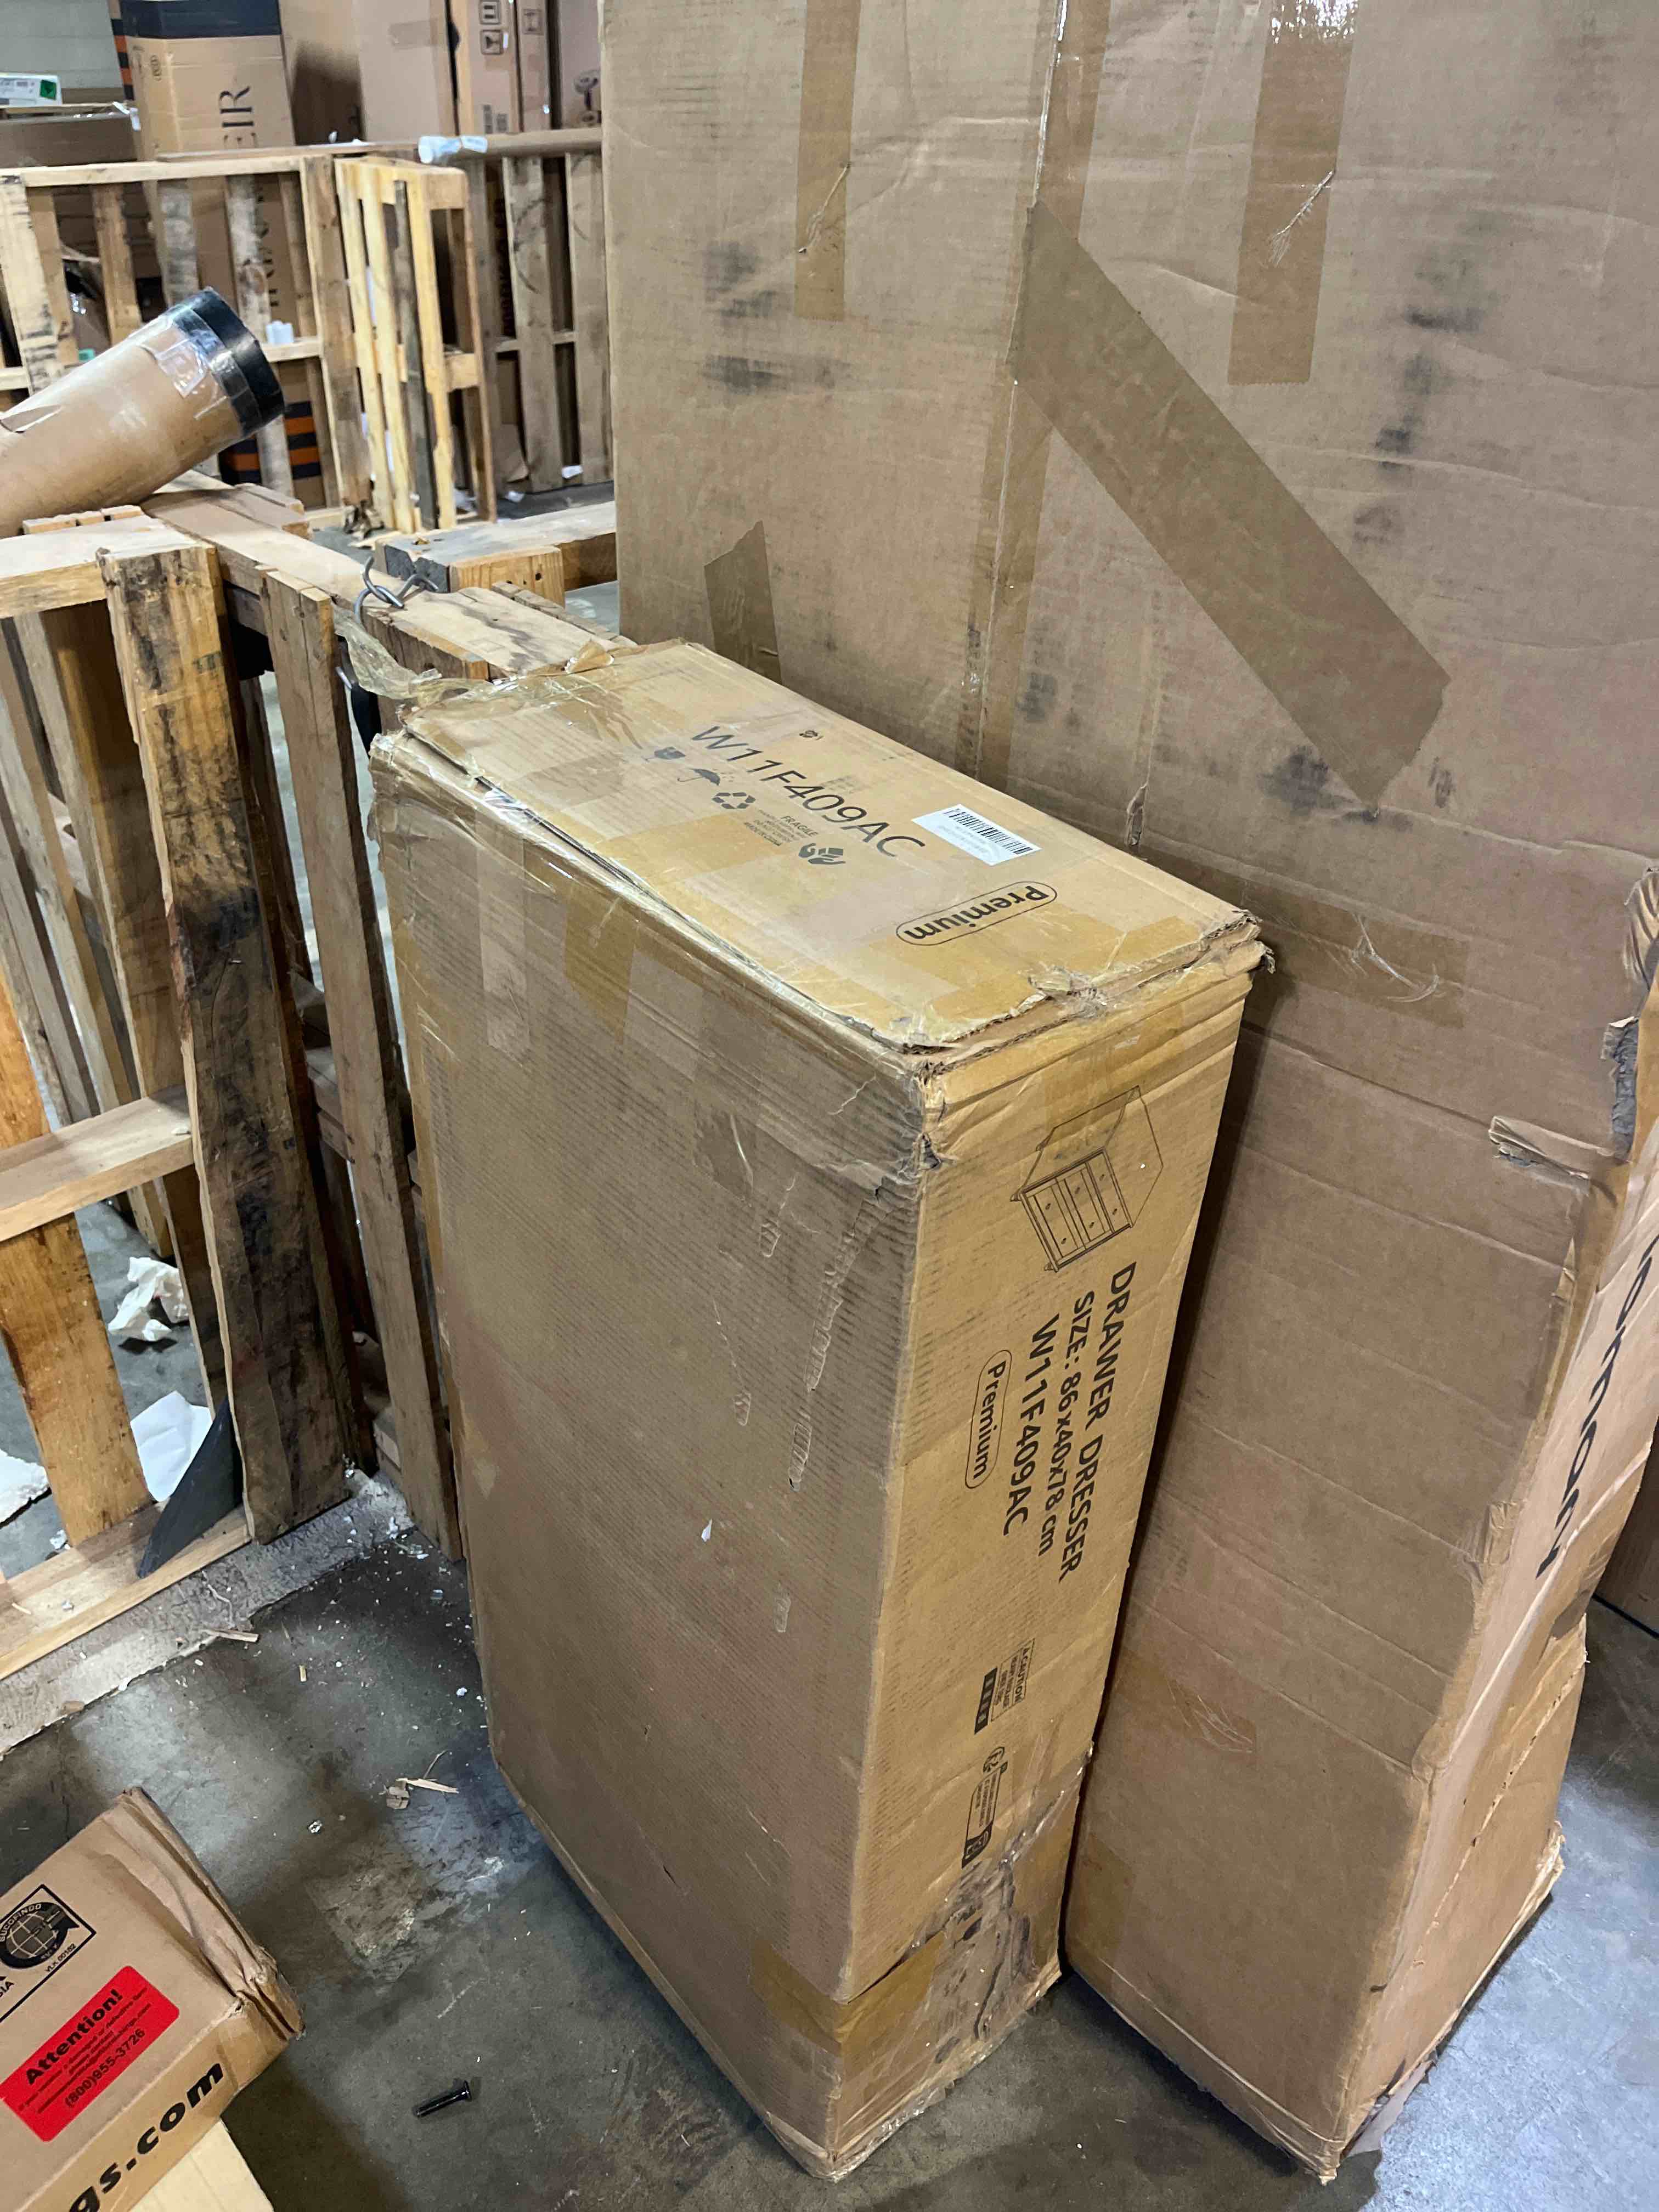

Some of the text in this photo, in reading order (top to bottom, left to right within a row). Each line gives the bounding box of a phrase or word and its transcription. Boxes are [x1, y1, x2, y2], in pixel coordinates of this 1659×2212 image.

[692, 725, 926, 857] W11F409AC
[781, 816, 819, 837] FRAGILE
[904, 885, 1049, 940] Premium
[1064, 1291, 1094, 1370] SIZE:
[973, 1361, 1006, 1479] Premium
[1003, 1313, 1060, 1537] W11F409AC
[1059, 1262, 1137, 1583] DRAWER DRESSER
[1536, 1233, 1659, 1579] omary
[1038, 1514, 1056, 1556] cm
[26, 1989, 123, 2085] Attention!
